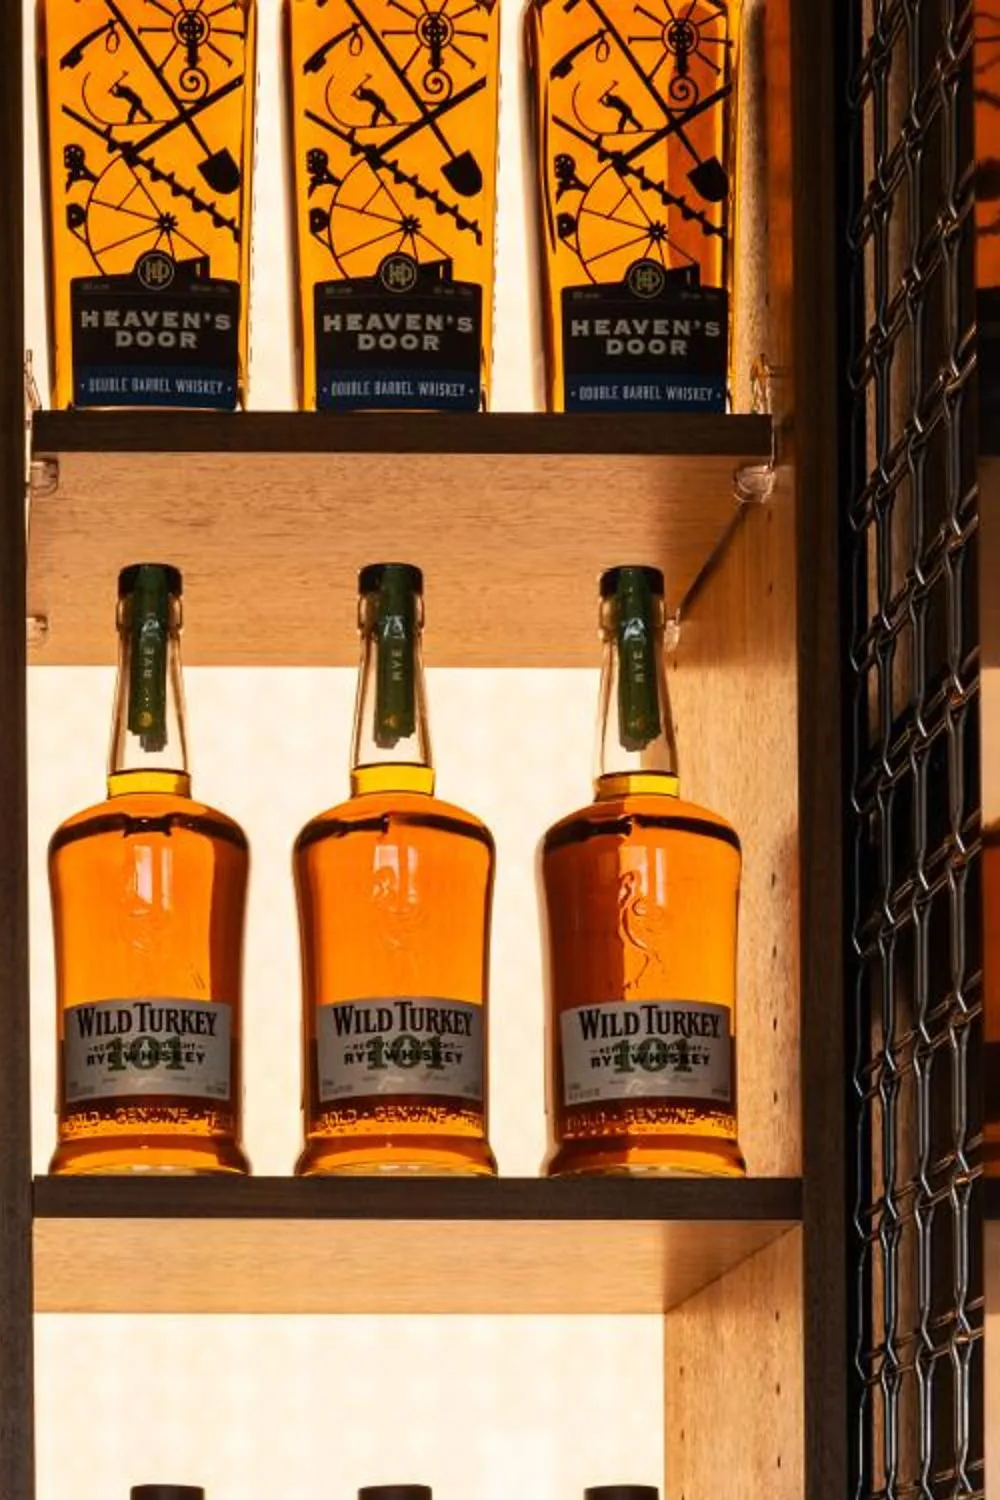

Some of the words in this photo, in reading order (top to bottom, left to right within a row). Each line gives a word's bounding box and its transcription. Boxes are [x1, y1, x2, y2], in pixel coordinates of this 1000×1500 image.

[81, 310, 232, 331] HEAVEN'S
[323, 313, 474, 333] HEAVEN'S
[571, 319, 721, 337] HEAVEN'S
[115, 331, 199, 349] DOOR
[357, 333, 440, 351] DOOR
[605, 338, 688, 356] DOOR
[89, 377, 127, 393] DOUBLE
[131, 377, 171, 393] BARREL
[175, 379, 223, 395] WHISKEY
[331, 380, 371, 397] DOUBLE
[374, 380, 415, 396] BARREL
[419, 381, 465, 397] WHISKEY
[580, 385, 619, 401] DOUBLE
[622, 385, 662, 401] BARREL
[665, 385, 713, 401] WHISKEY
[142, 646, 154, 679] RYE
[391, 648, 403, 681] RYE
[633, 651, 644, 683] RYE
[76, 1007, 133, 1039] WILD
[133, 1002, 217, 1037] TURKEY
[333, 1004, 393, 1038] WILD
[394, 1001, 472, 1037] TURKEY
[578, 1008, 640, 1040] WILD
[640, 1004, 721, 1039] TURKEY
[106, 1036, 186, 1071] 101
[366, 1035, 444, 1070] 101
[612, 1038, 692, 1072] 101
